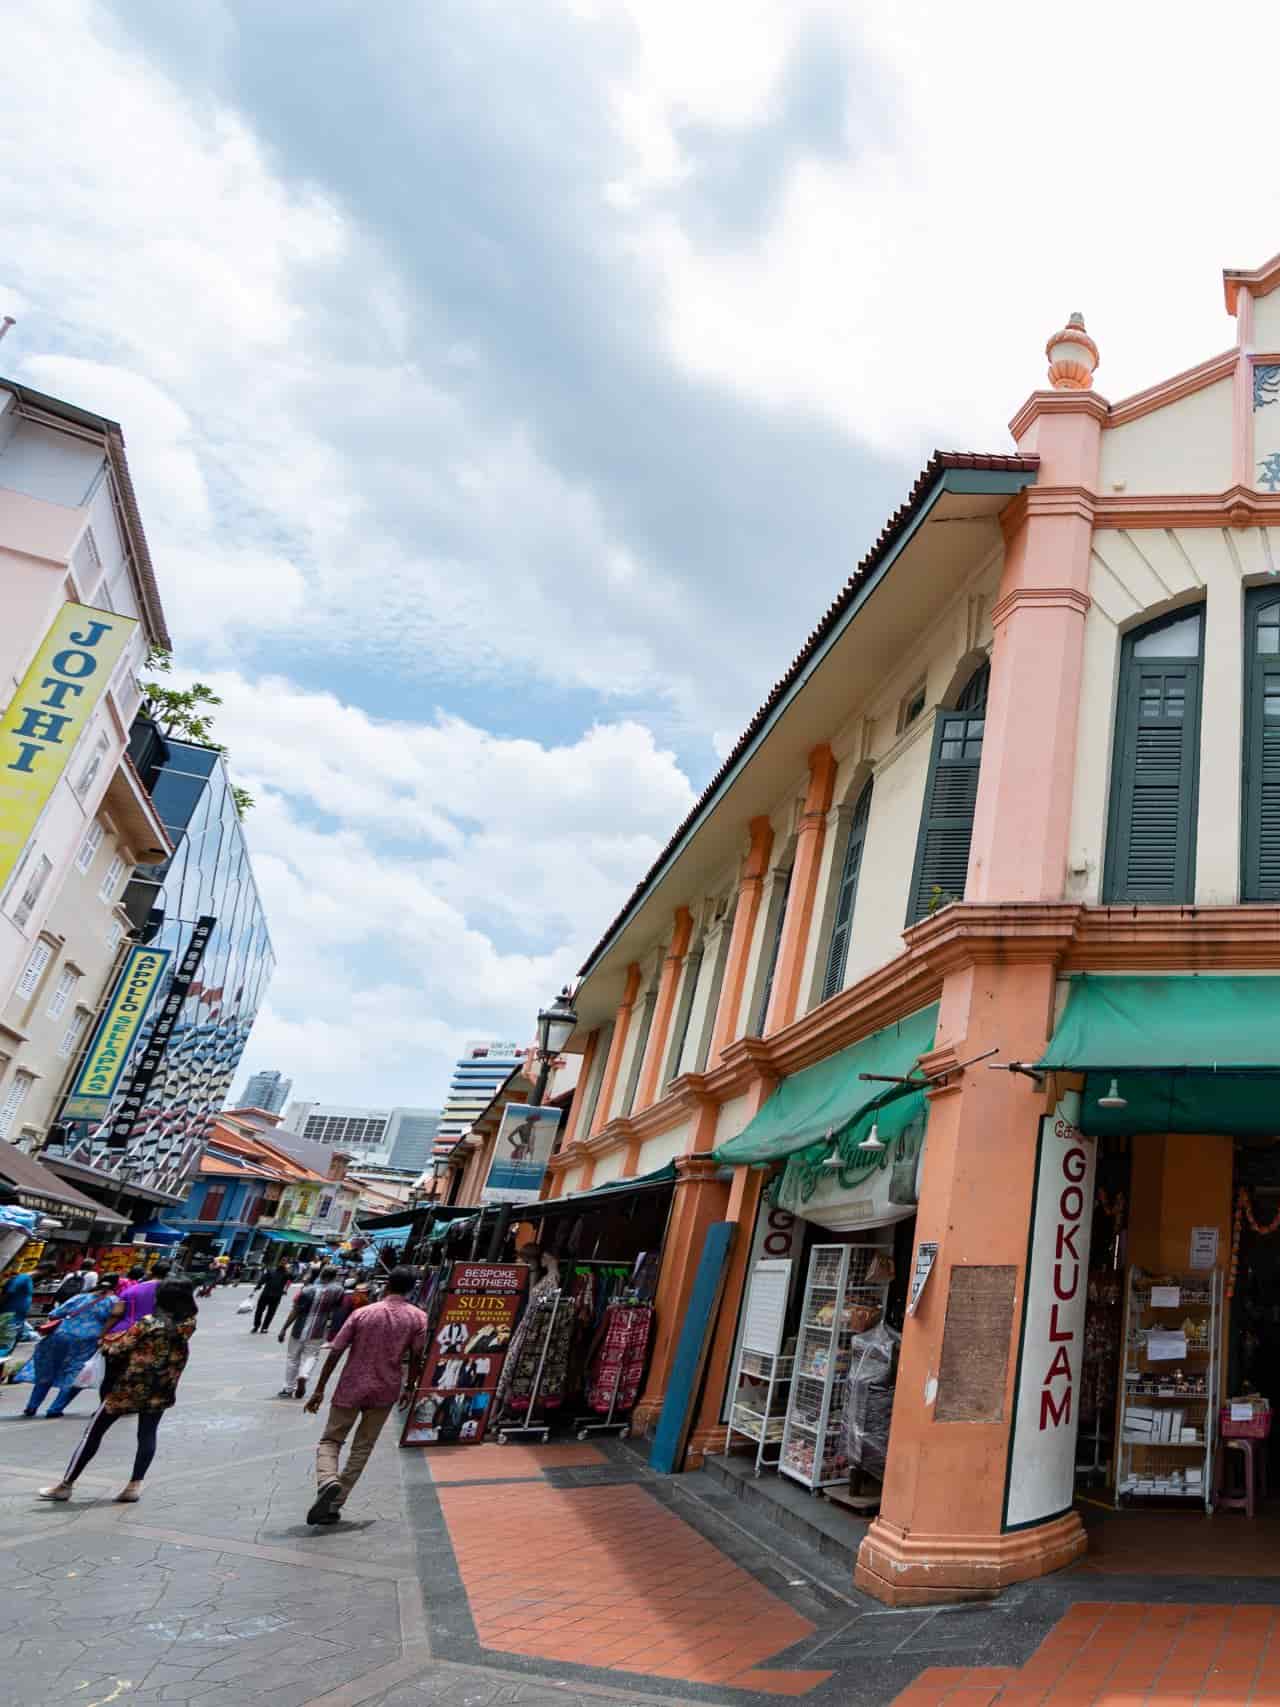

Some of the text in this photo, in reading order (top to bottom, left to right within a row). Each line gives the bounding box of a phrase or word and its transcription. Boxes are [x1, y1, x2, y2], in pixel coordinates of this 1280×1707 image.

[7, 620, 113, 773] JOTHI
[464, 1269, 517, 1279] BESPOKE
[457, 1278, 519, 1288] CLOTHIERS
[1038, 1147, 1087, 1431] GOKULAM
[458, 1296, 505, 1309] SUITS
